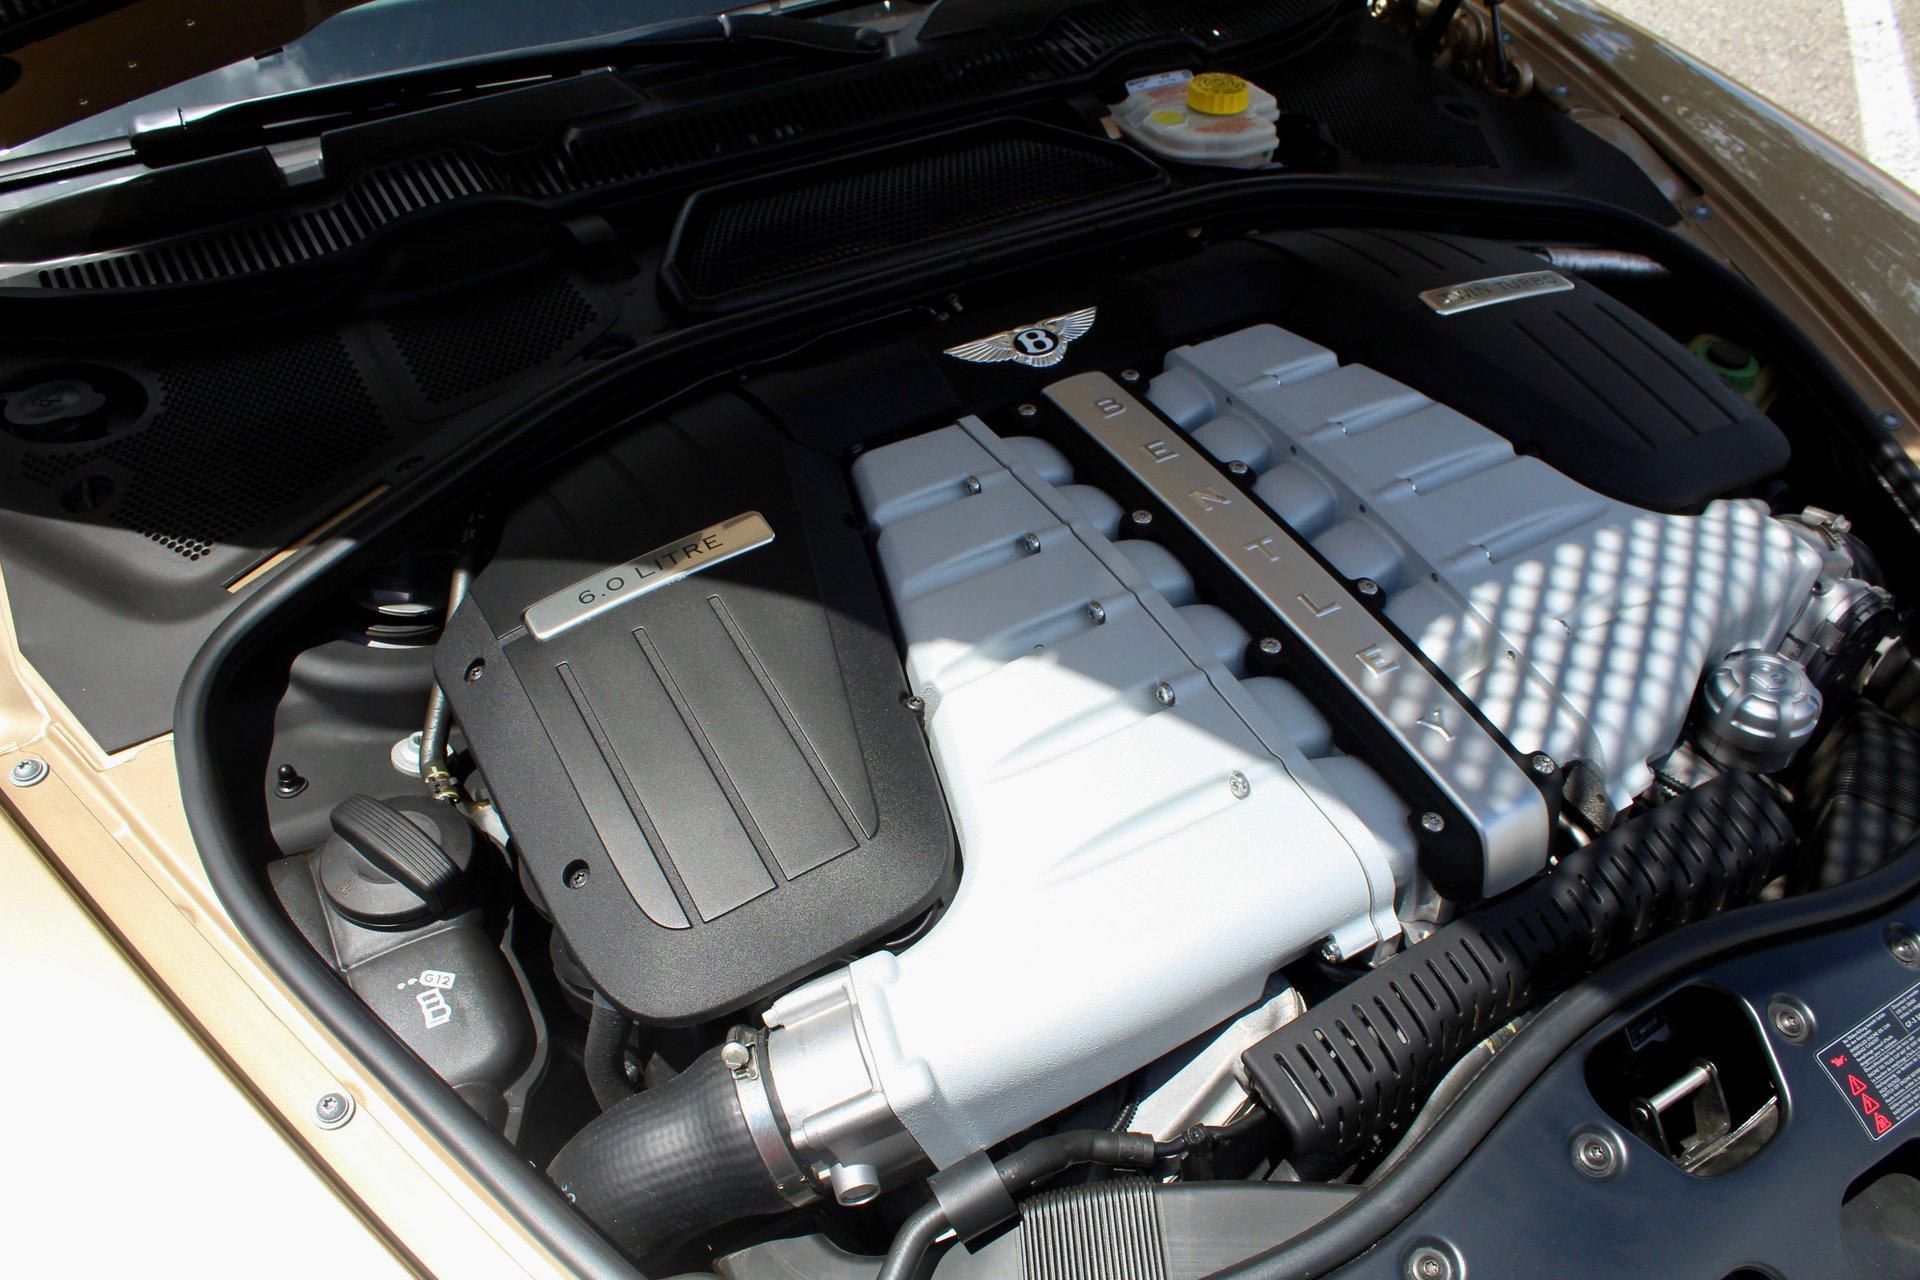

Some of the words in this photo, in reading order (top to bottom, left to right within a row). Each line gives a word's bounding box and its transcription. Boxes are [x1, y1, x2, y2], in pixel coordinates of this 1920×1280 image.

[1439, 286, 1492, 301] TWIN
[1495, 275, 1557, 290] TURBO
[578, 576, 625, 605] 6.0
[635, 534, 723, 580] LITRE
[1094, 397, 1456, 742] BENTLEY
[424, 973, 451, 986] G12
